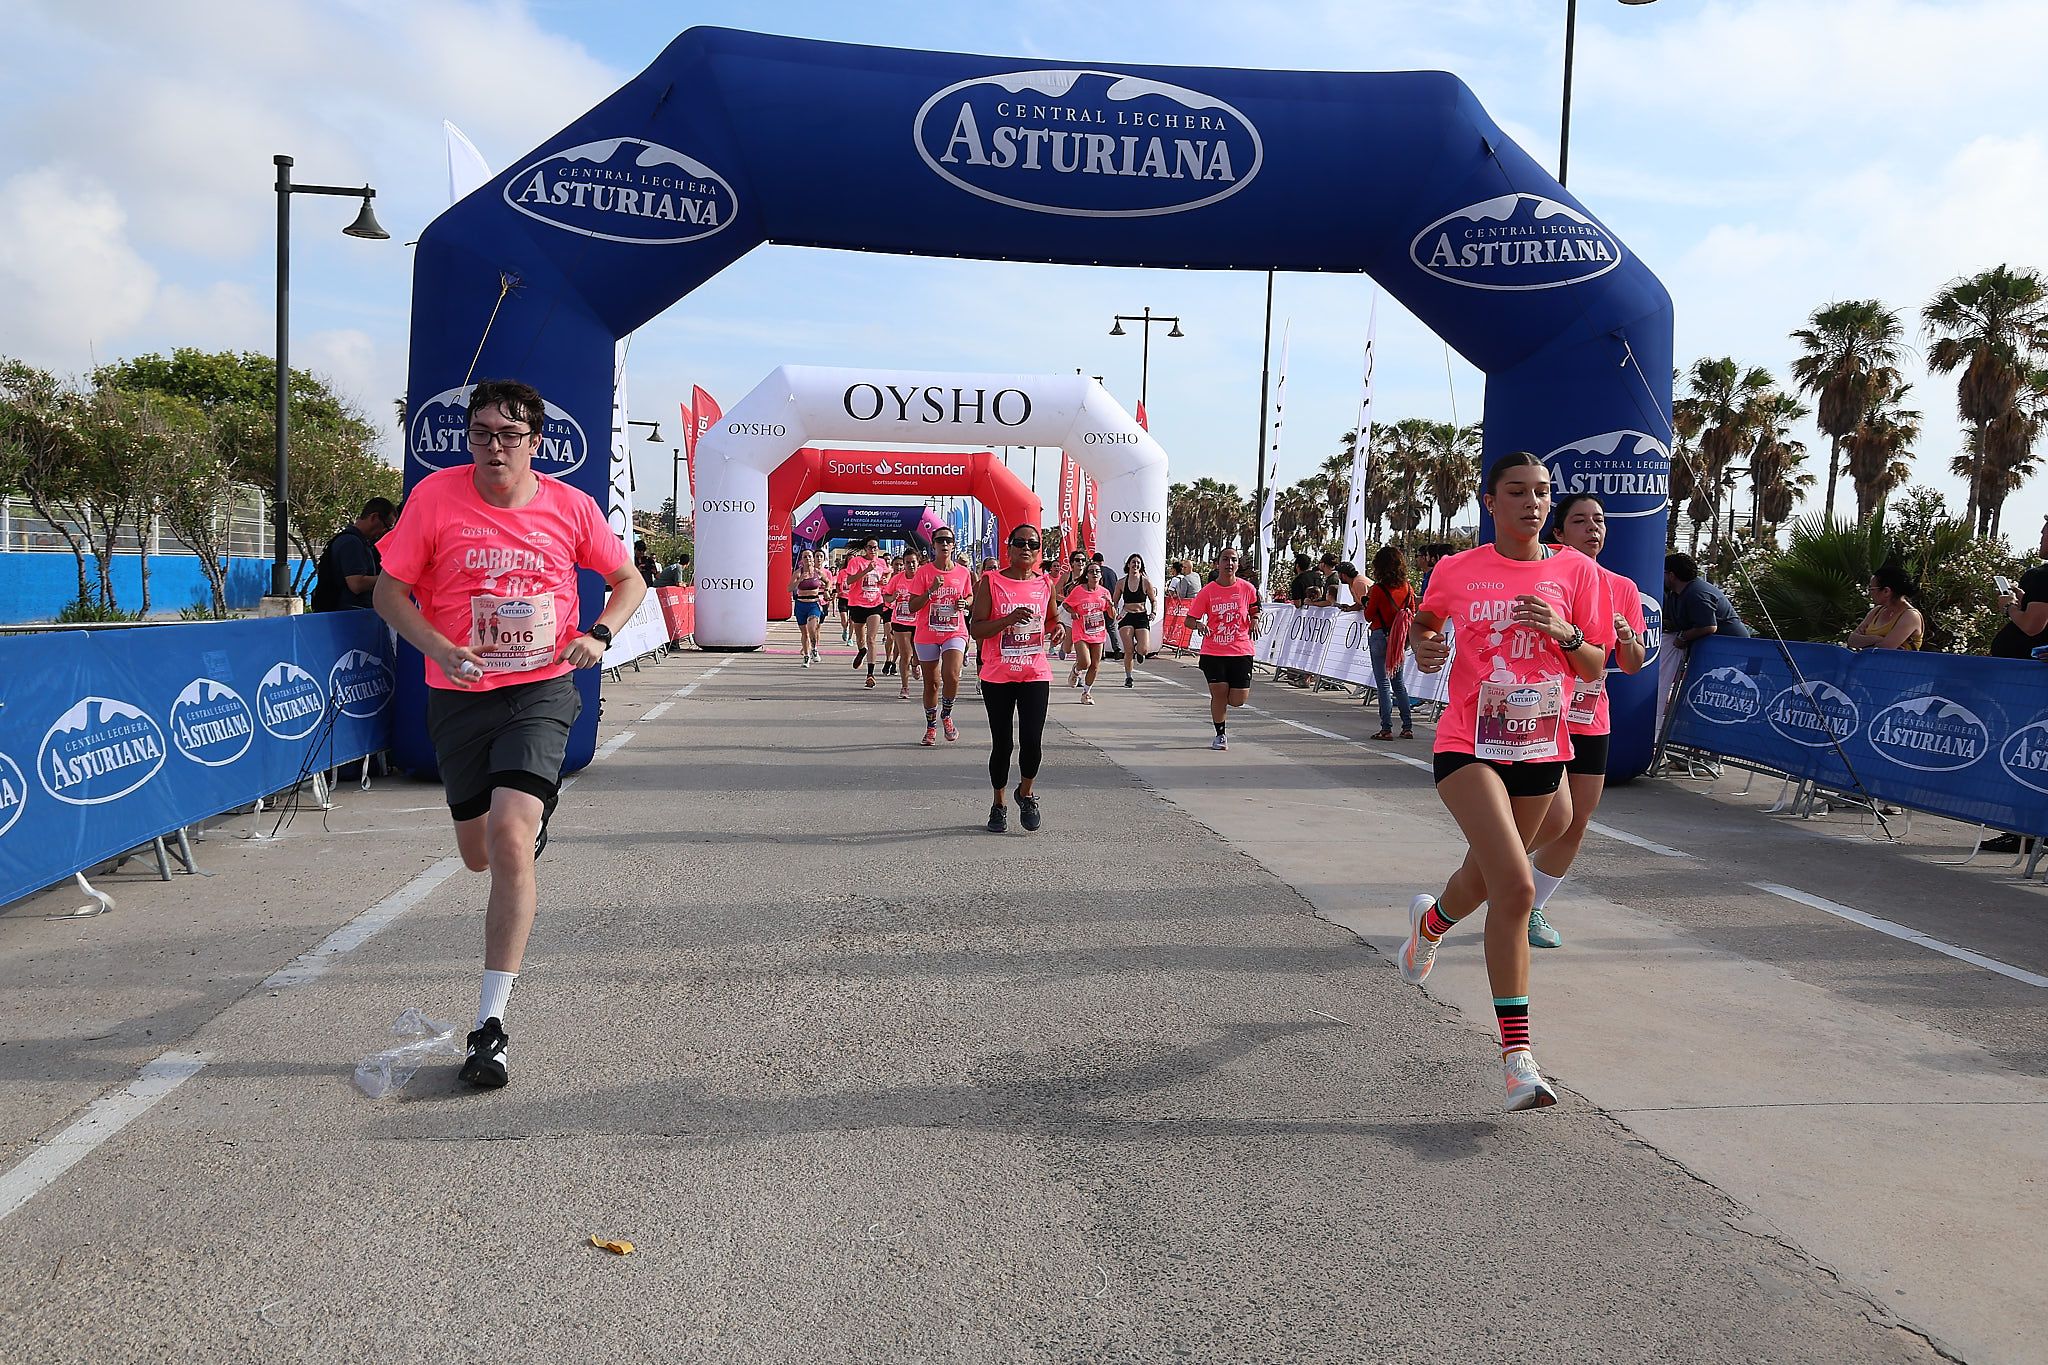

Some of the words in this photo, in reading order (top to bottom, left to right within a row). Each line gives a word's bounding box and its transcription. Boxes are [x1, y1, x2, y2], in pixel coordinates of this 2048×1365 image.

[997, 102, 1106, 124] CENTRAL
[1118, 111, 1227, 131] LECHERA
[940, 102, 1236, 182] ASTURIANA
[558, 167, 633, 183] CENTRAL
[641, 174, 717, 195] LECHERA
[516, 170, 719, 226] ASTURIANA
[1464, 225, 1536, 239] CENTRAL
[1542, 225, 1599, 237] LECHERA
[1427, 232, 1614, 267] ASTURIANA
[842, 382, 1032, 427] OYSHO
[728, 423, 786, 437] OYSHO
[1083, 431, 1139, 445] OYSHO
[828, 459, 873, 477] Sports
[894, 461, 966, 476] Santander
[1573, 460, 1633, 469] CENTRAL
[702, 500, 756, 514] OYSHO
[1110, 510, 1161, 524] OYSHO
[461, 527, 499, 537] OYSHO
[701, 577, 754, 591] OYSHO
[1466, 581, 1505, 591] OYSHO
[500, 630, 534, 644] 016
[1014, 633, 1031, 642] 016
[1290, 615, 1331, 645] OYSHO
[186, 706, 215, 722] CENTRAL
[214, 702, 242, 717] LECHERA
[263, 693, 322, 726] ASTURIANA
[1769, 699, 1849, 736] ASTURIANA
[106, 721, 151, 742] LECHERA
[178, 713, 251, 751] ASTURIANA
[1506, 718, 1538, 732] 016
[1897, 716, 1935, 729] CENTRAL
[1937, 724, 1978, 736] LECHERA
[1873, 716, 1976, 759] ASTURIANA
[1485, 747, 1514, 756] OYSHO
[52, 734, 162, 792] ASTURIANA
